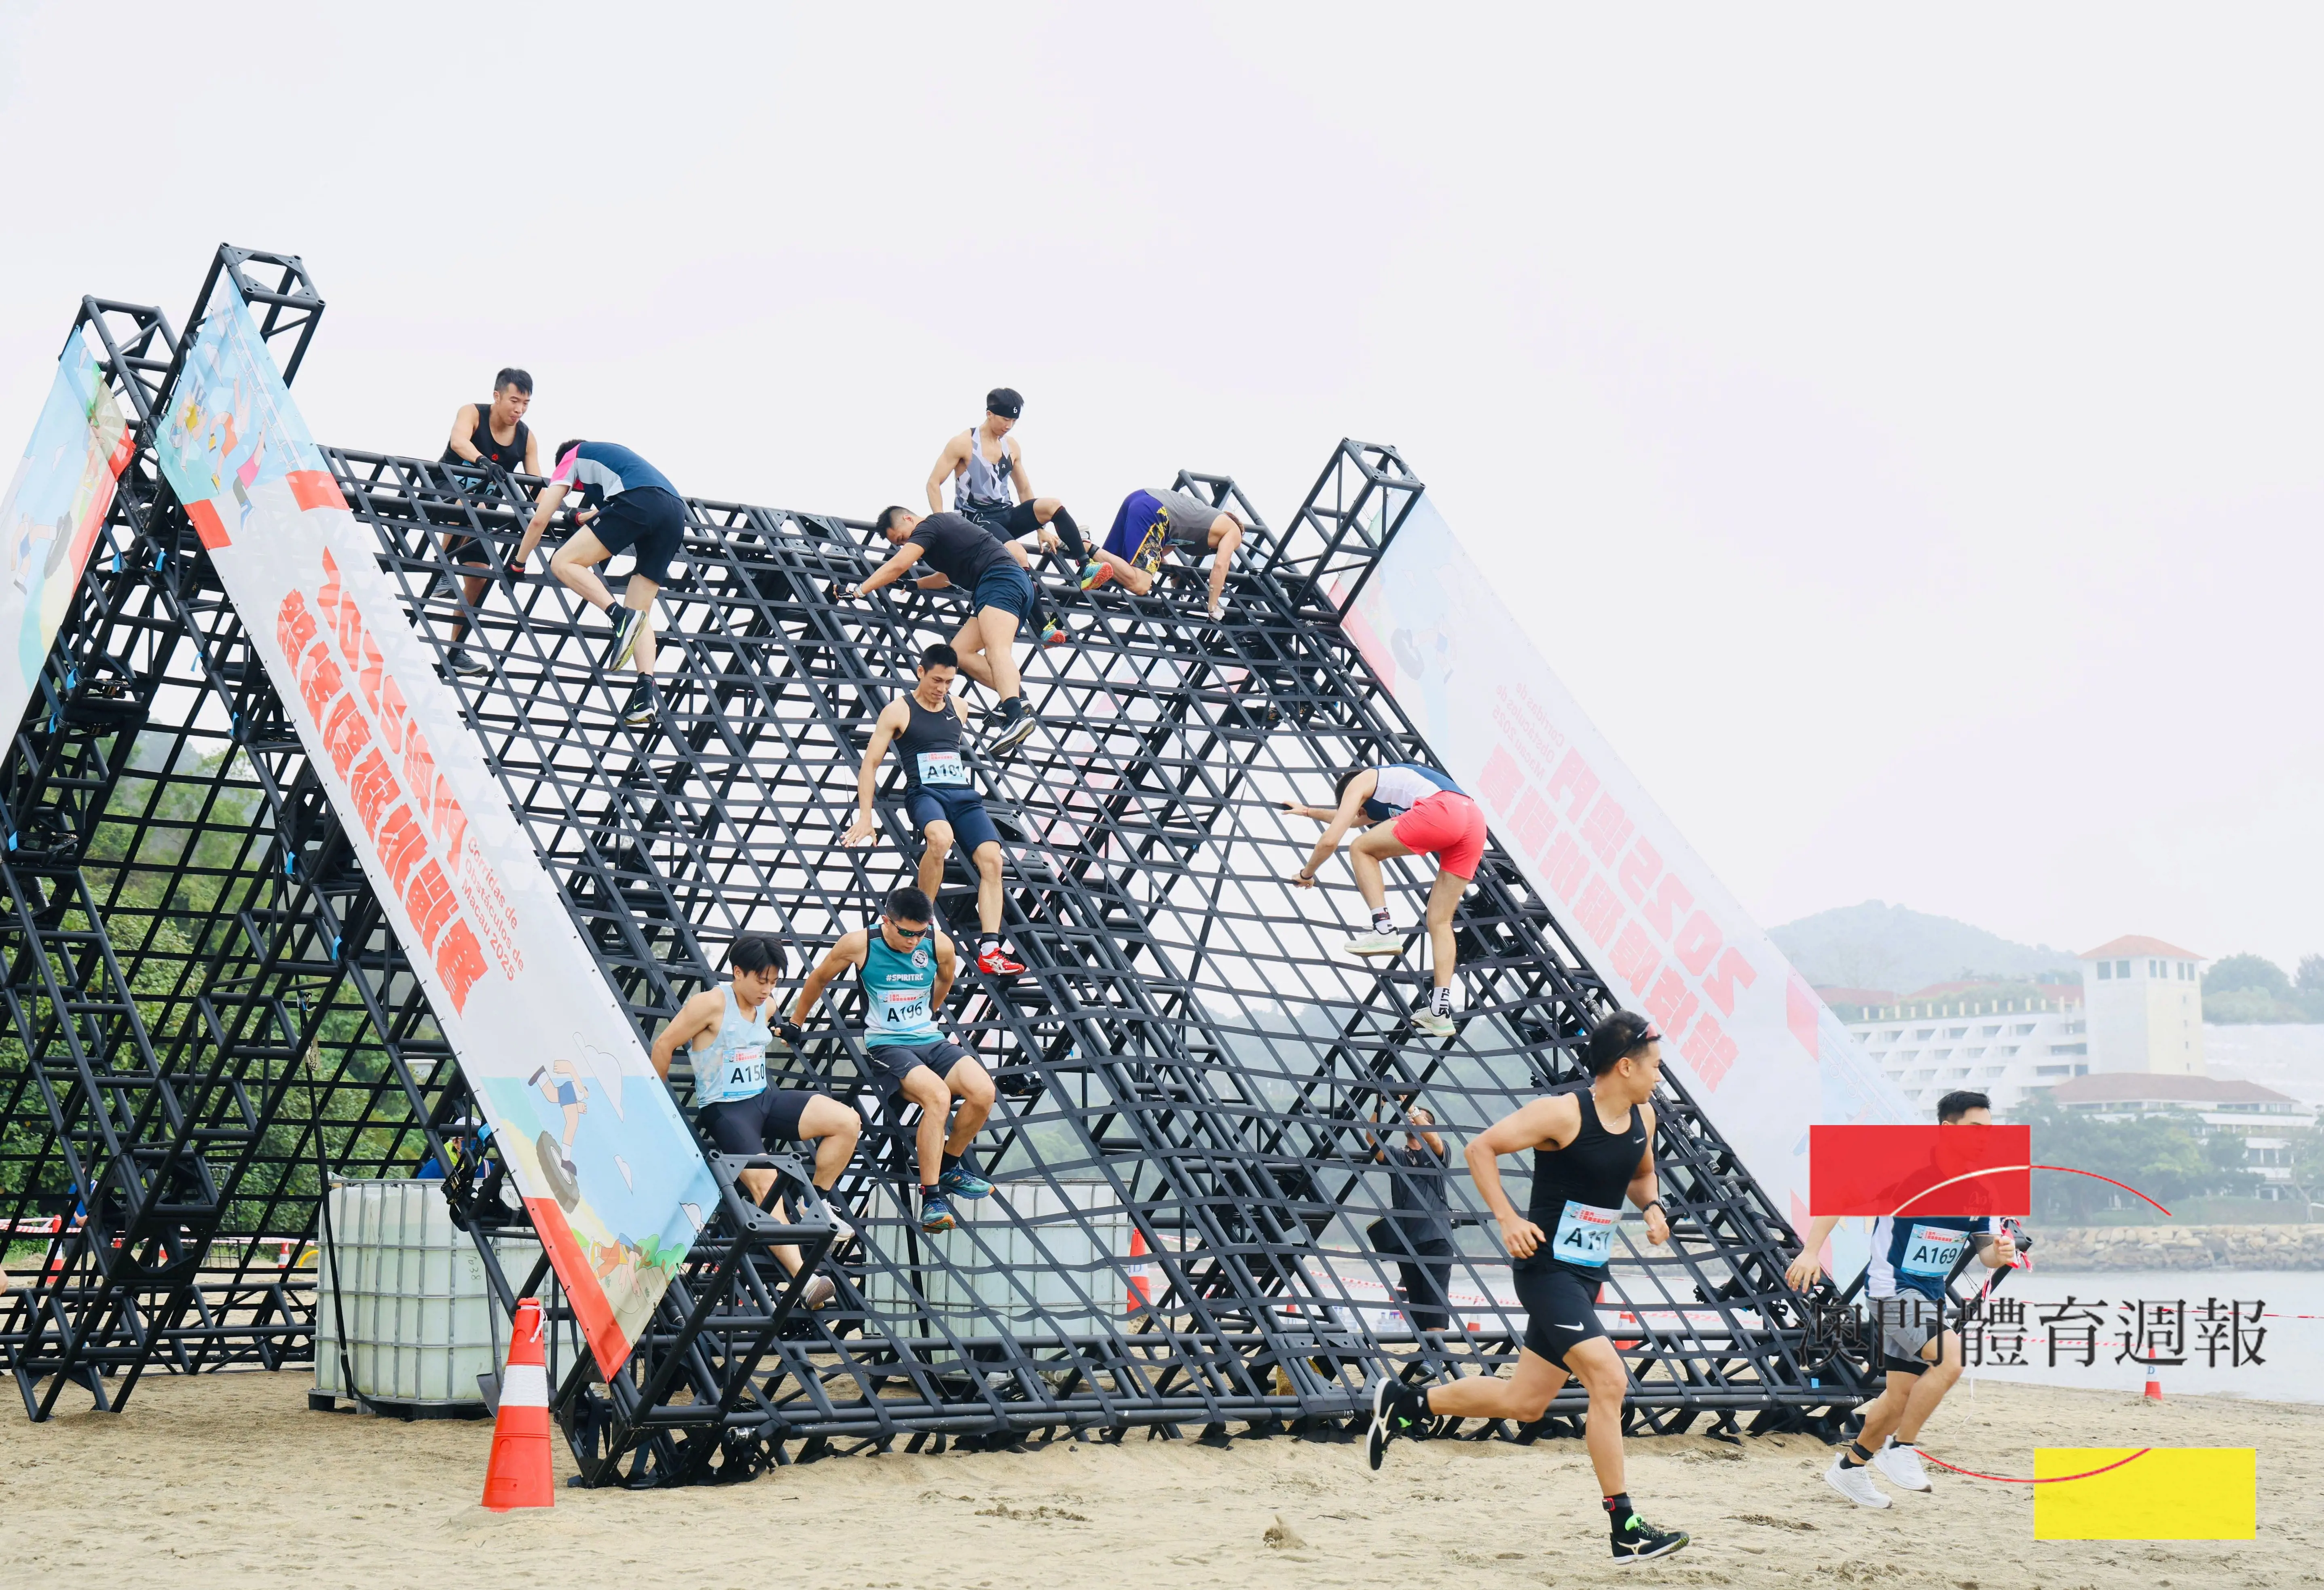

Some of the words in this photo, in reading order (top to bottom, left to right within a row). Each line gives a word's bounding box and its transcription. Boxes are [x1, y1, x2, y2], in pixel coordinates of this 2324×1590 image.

[468, 836, 505, 908] Corridas
[505, 906, 517, 930] de
[462, 878, 491, 937] Macau
[490, 932, 515, 981] 2025
[465, 858, 512, 950] Obstáculos
[512, 948, 524, 971] de
[887, 1001, 922, 1022] A196
[730, 1064, 764, 1084] A150
[1912, 1246, 1958, 1265] A169
